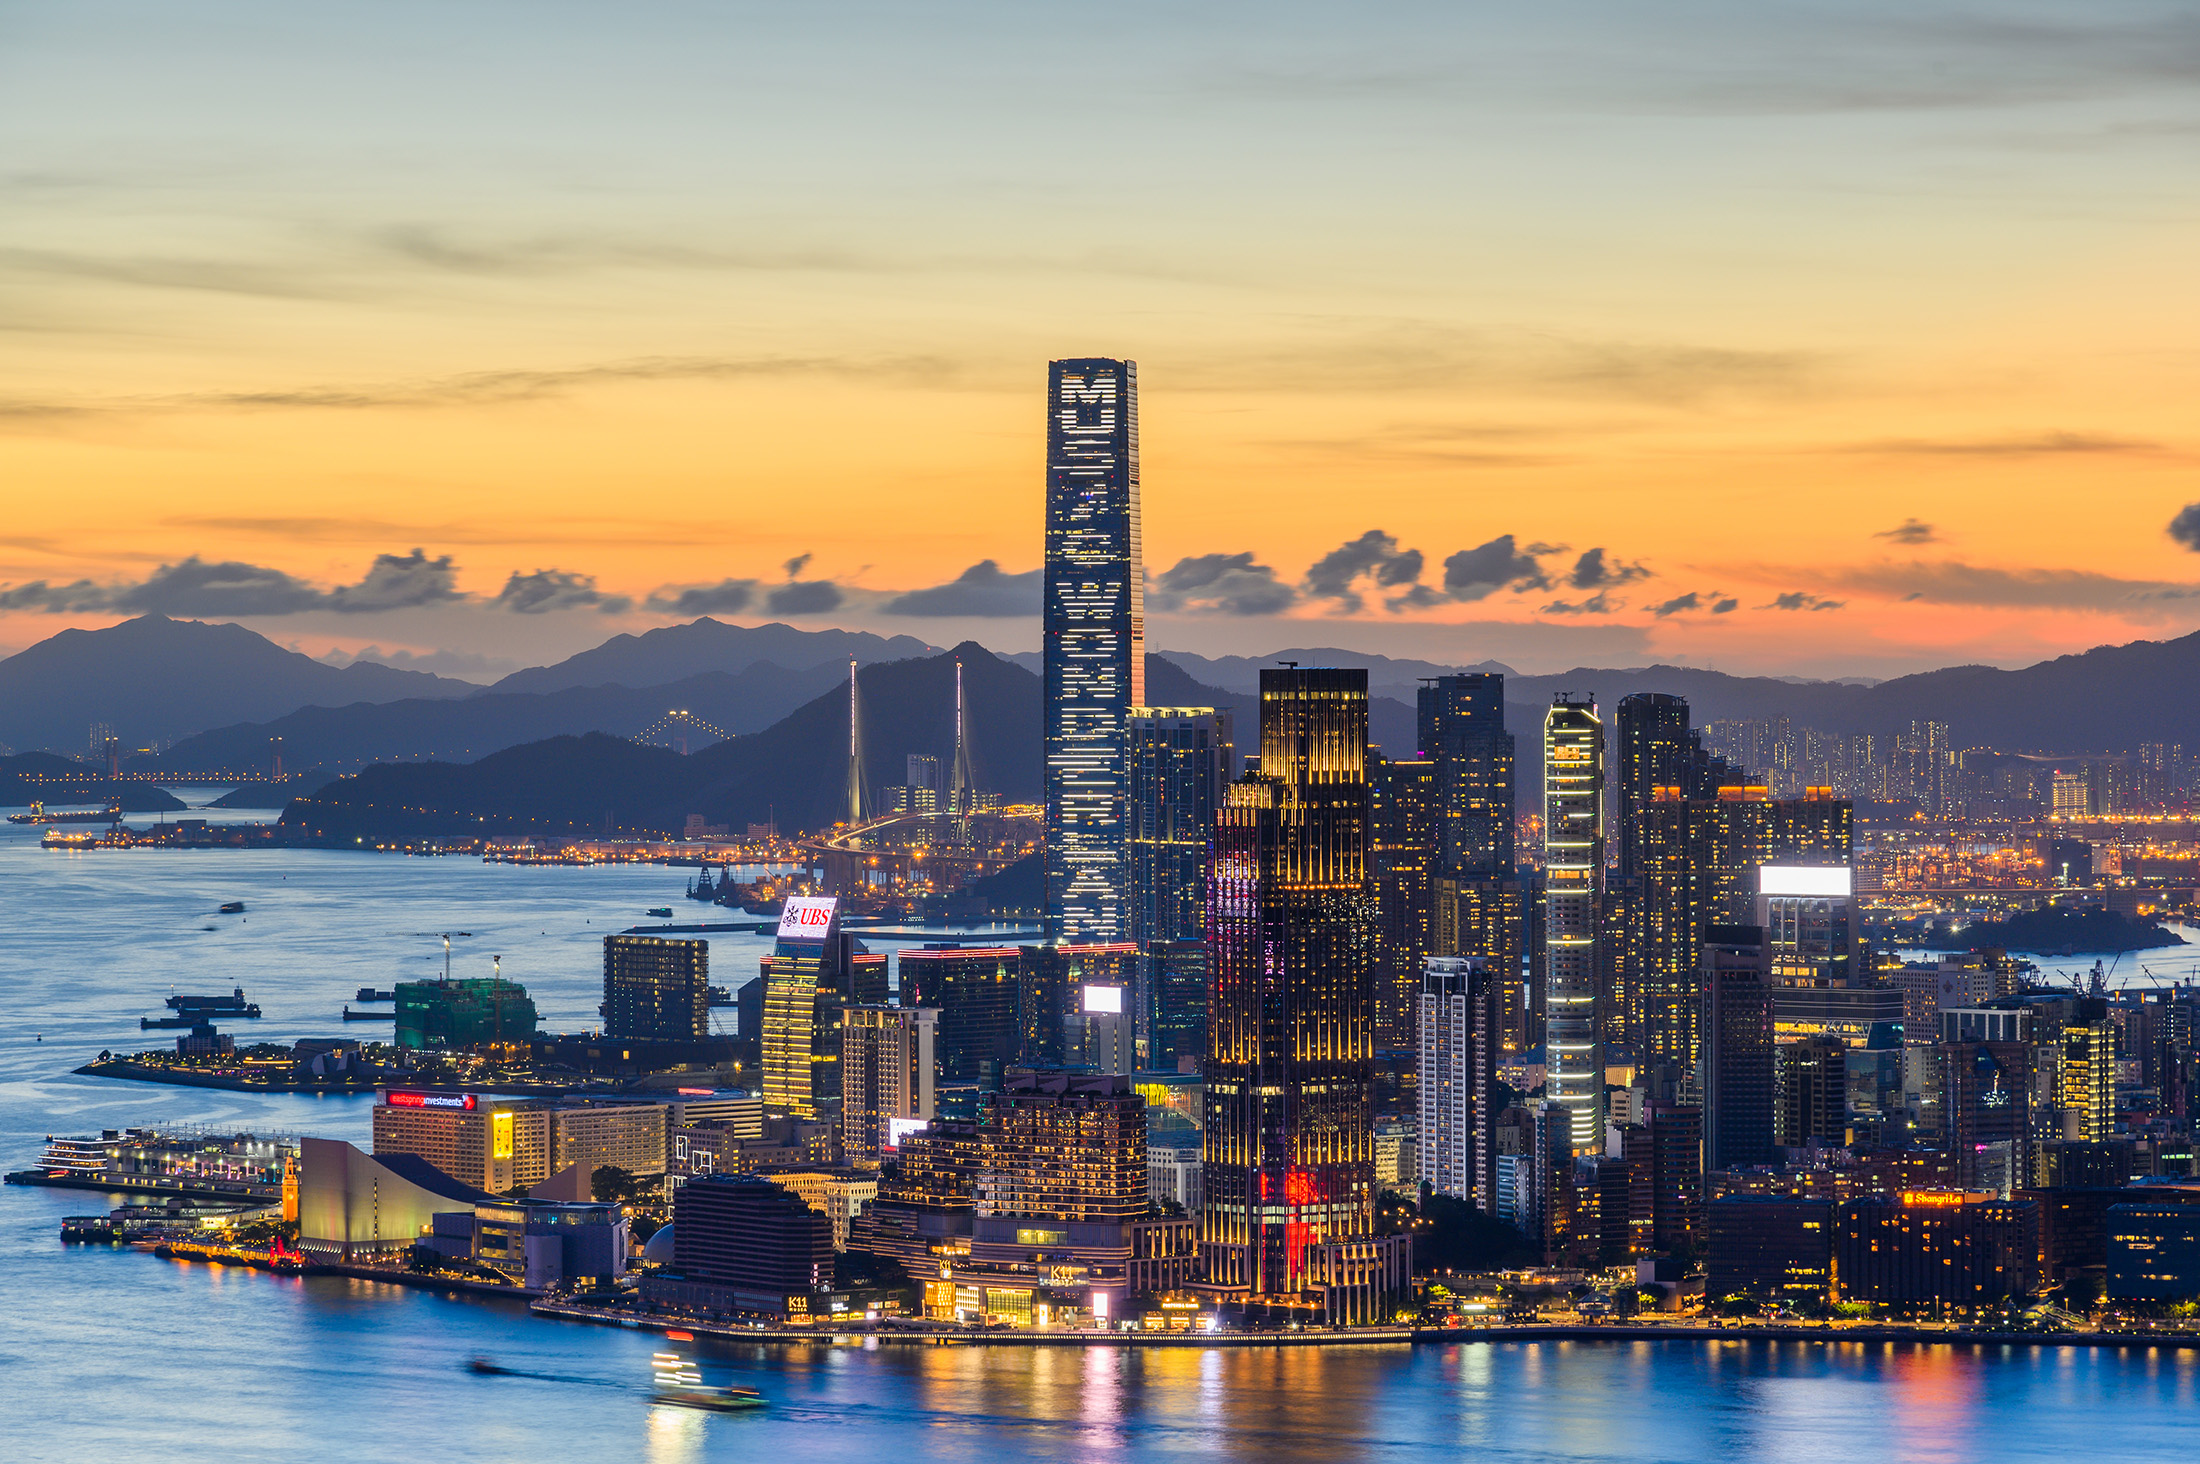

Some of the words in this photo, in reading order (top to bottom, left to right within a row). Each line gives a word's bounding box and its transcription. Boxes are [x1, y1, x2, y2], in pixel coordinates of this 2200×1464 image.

[800, 908, 830, 925] UBS
[1050, 1265, 1074, 1280] K11
[788, 1296, 808, 1308] K11
